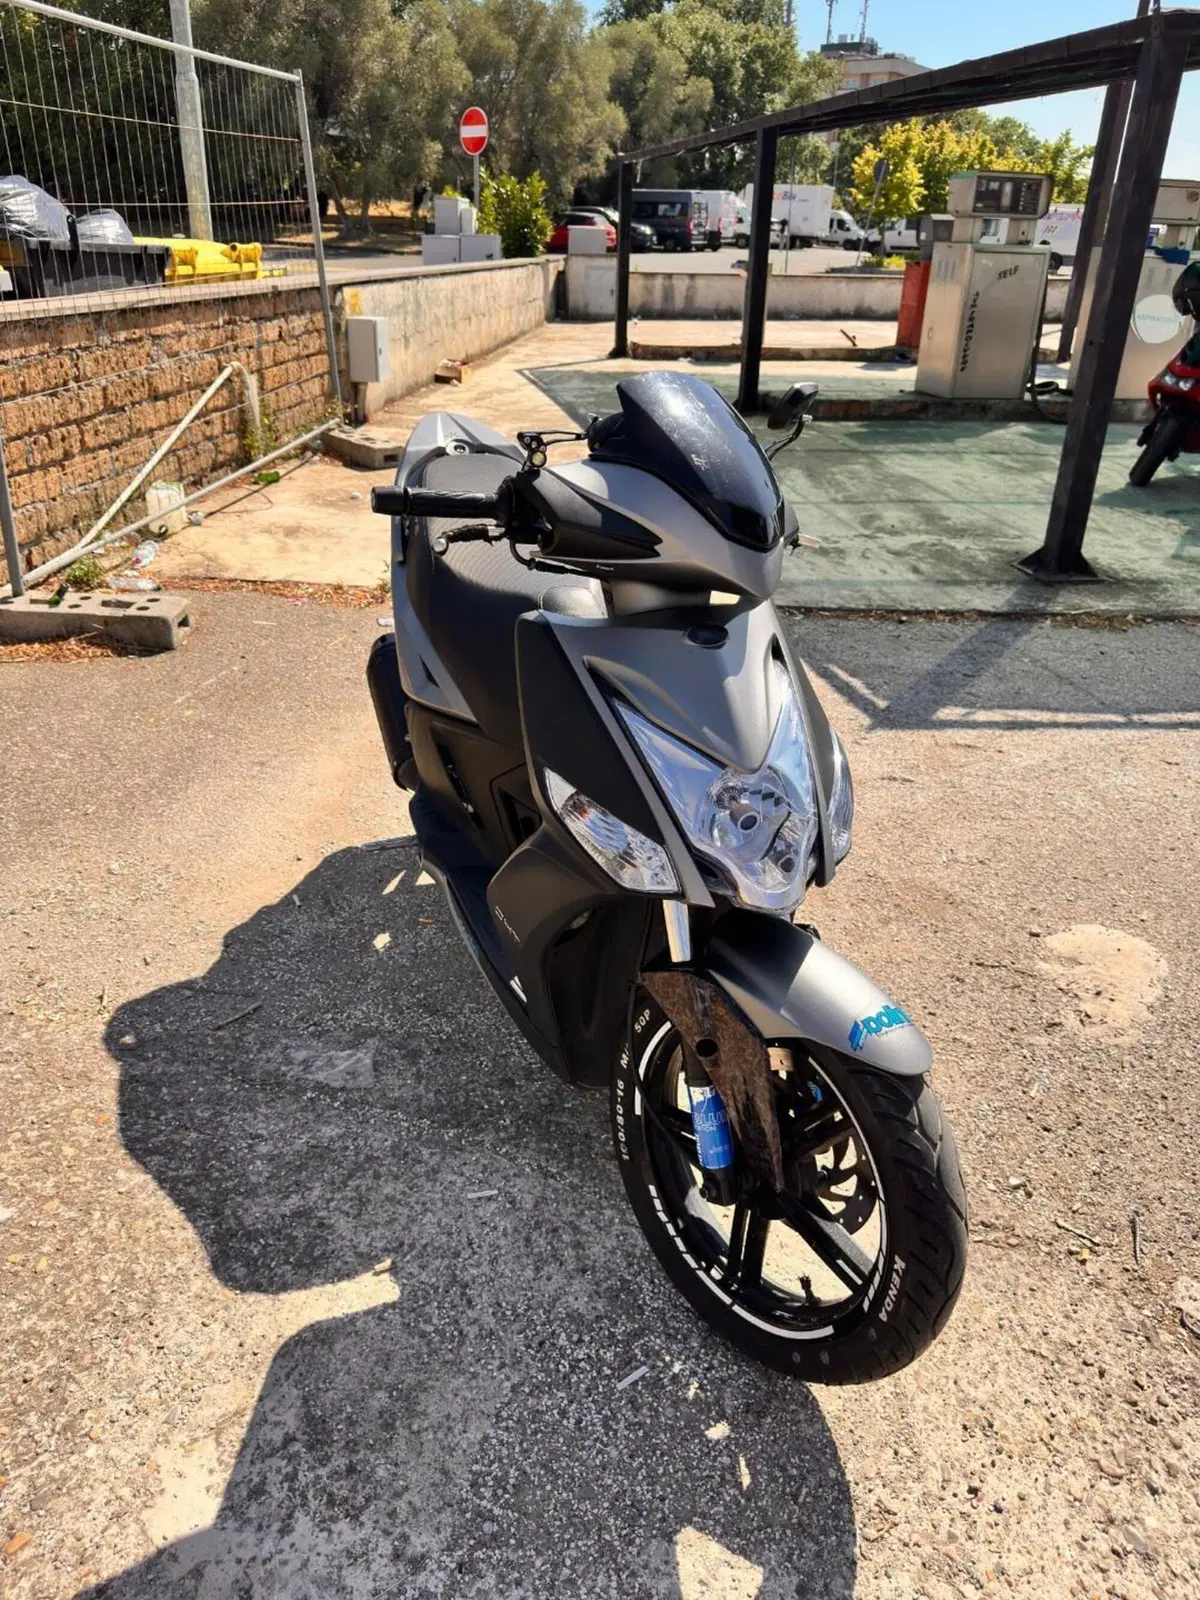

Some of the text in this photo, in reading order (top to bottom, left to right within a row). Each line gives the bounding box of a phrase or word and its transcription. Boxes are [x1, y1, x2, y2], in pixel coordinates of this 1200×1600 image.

[998, 265, 1020, 281] SELF
[616, 1009, 650, 1160] 100/80-16 M/ 50P
[878, 1254, 906, 1322] KENDA
